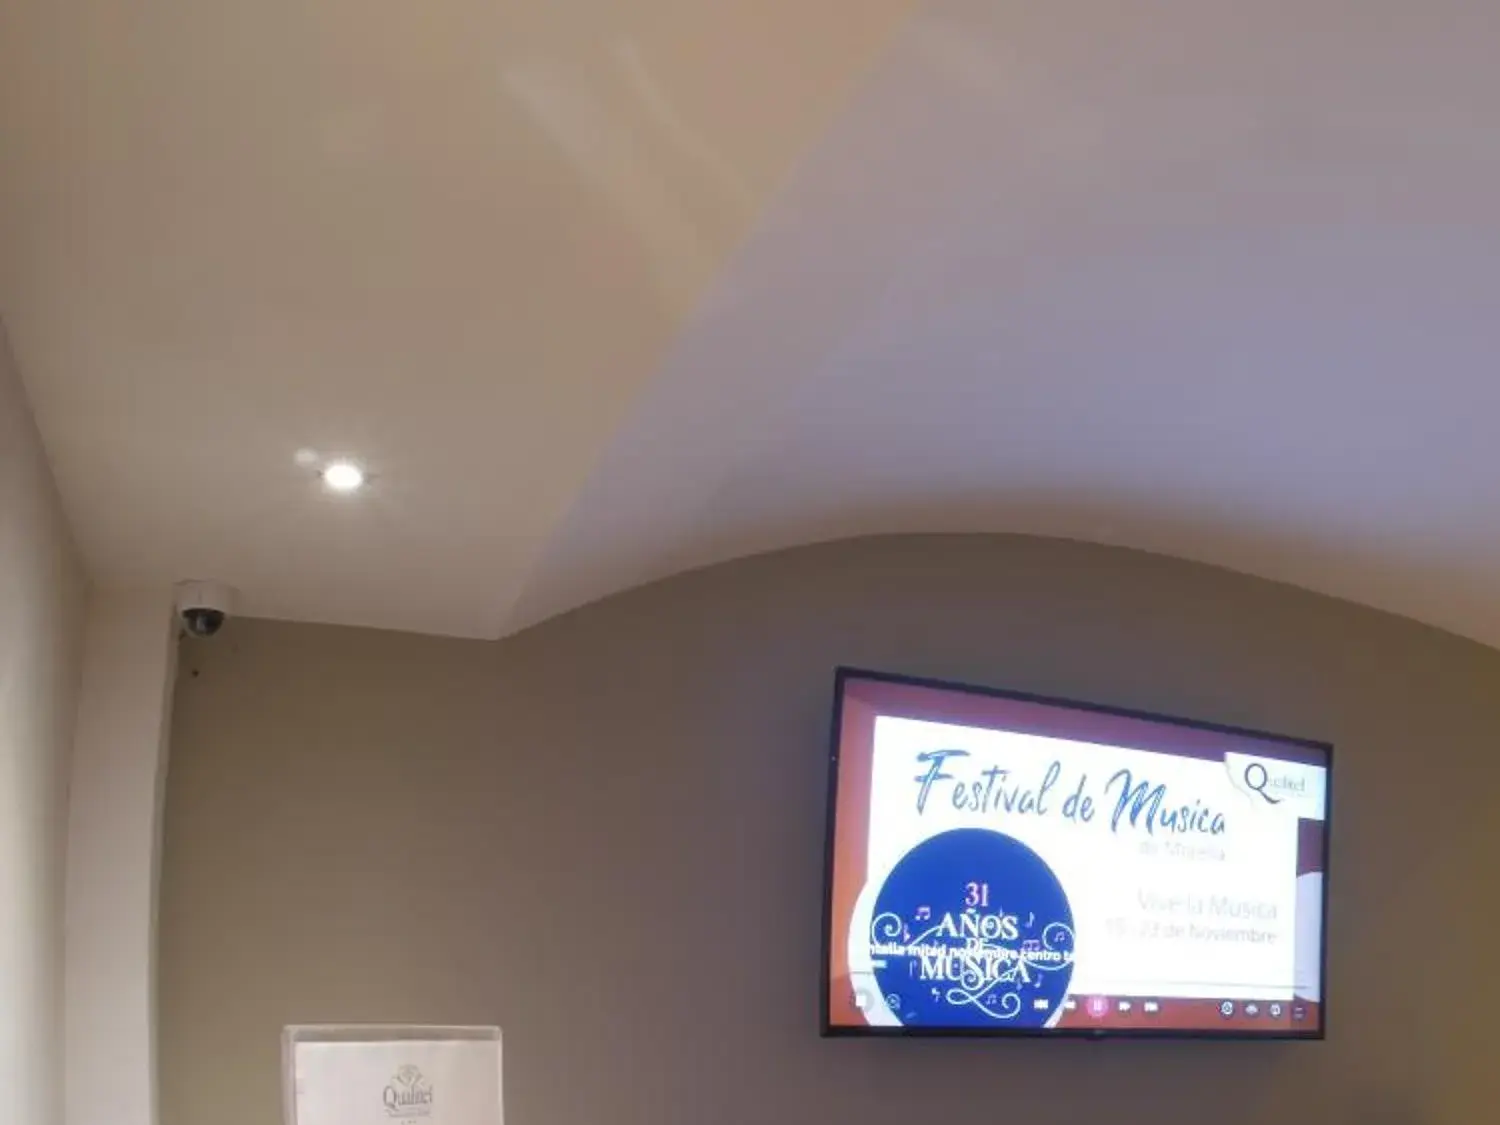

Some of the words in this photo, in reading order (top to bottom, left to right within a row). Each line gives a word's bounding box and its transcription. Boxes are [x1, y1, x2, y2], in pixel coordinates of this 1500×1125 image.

[914, 749, 1062, 816] Festival
[1062, 773, 1096, 823] de
[1104, 768, 1226, 835] Musica
[965, 881, 989, 908] 31
[935, 908, 1020, 941] AÑOS
[1189, 922, 1279, 946] Noviembre
